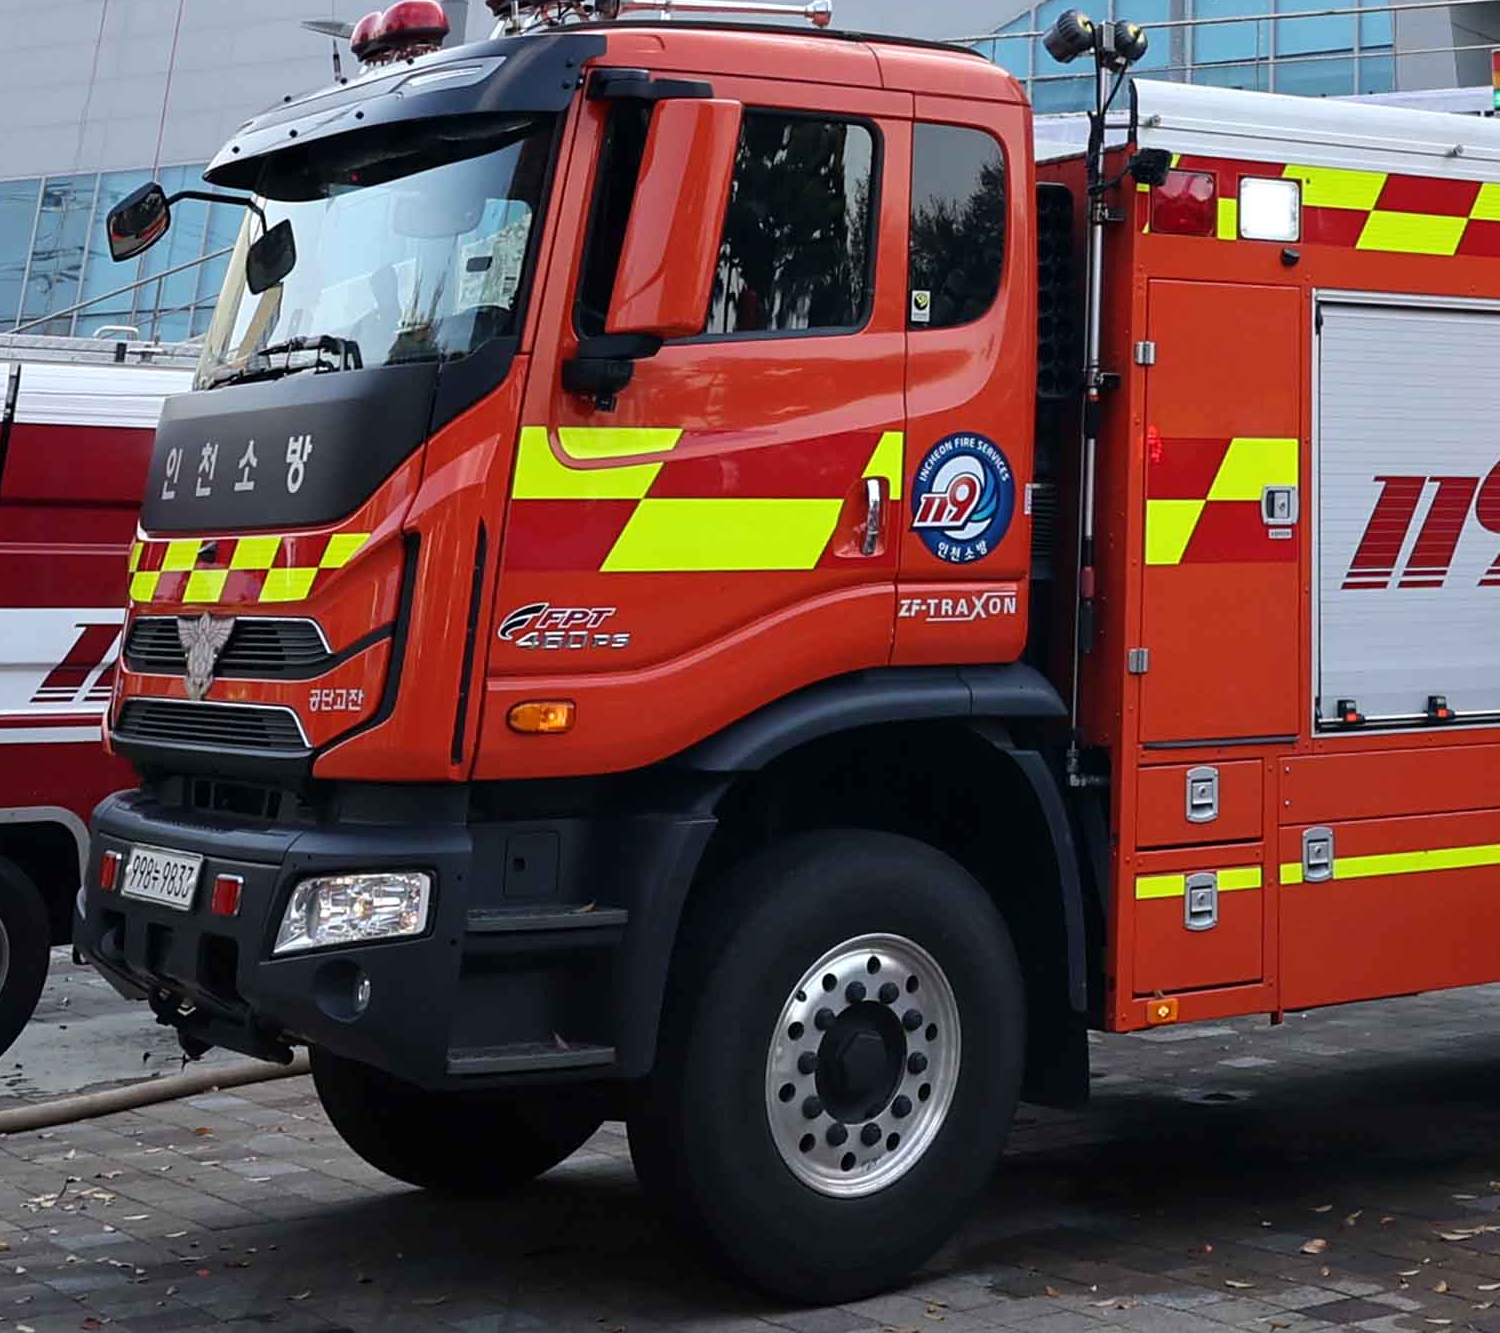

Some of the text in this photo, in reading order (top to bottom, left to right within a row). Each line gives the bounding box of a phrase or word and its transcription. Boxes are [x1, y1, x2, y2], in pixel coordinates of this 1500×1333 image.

[161, 434, 313, 501] 인천소방
[919, 437, 1011, 483] INCHEON FIRE SERVICES
[913, 473, 981, 527] 119
[937, 539, 989, 562] 인천소방
[535, 607, 617, 629] FPT
[899, 593, 1018, 621] ZF-TRAXON
[593, 633, 631, 649] PS
[308, 688, 365, 712] 공단고잔
